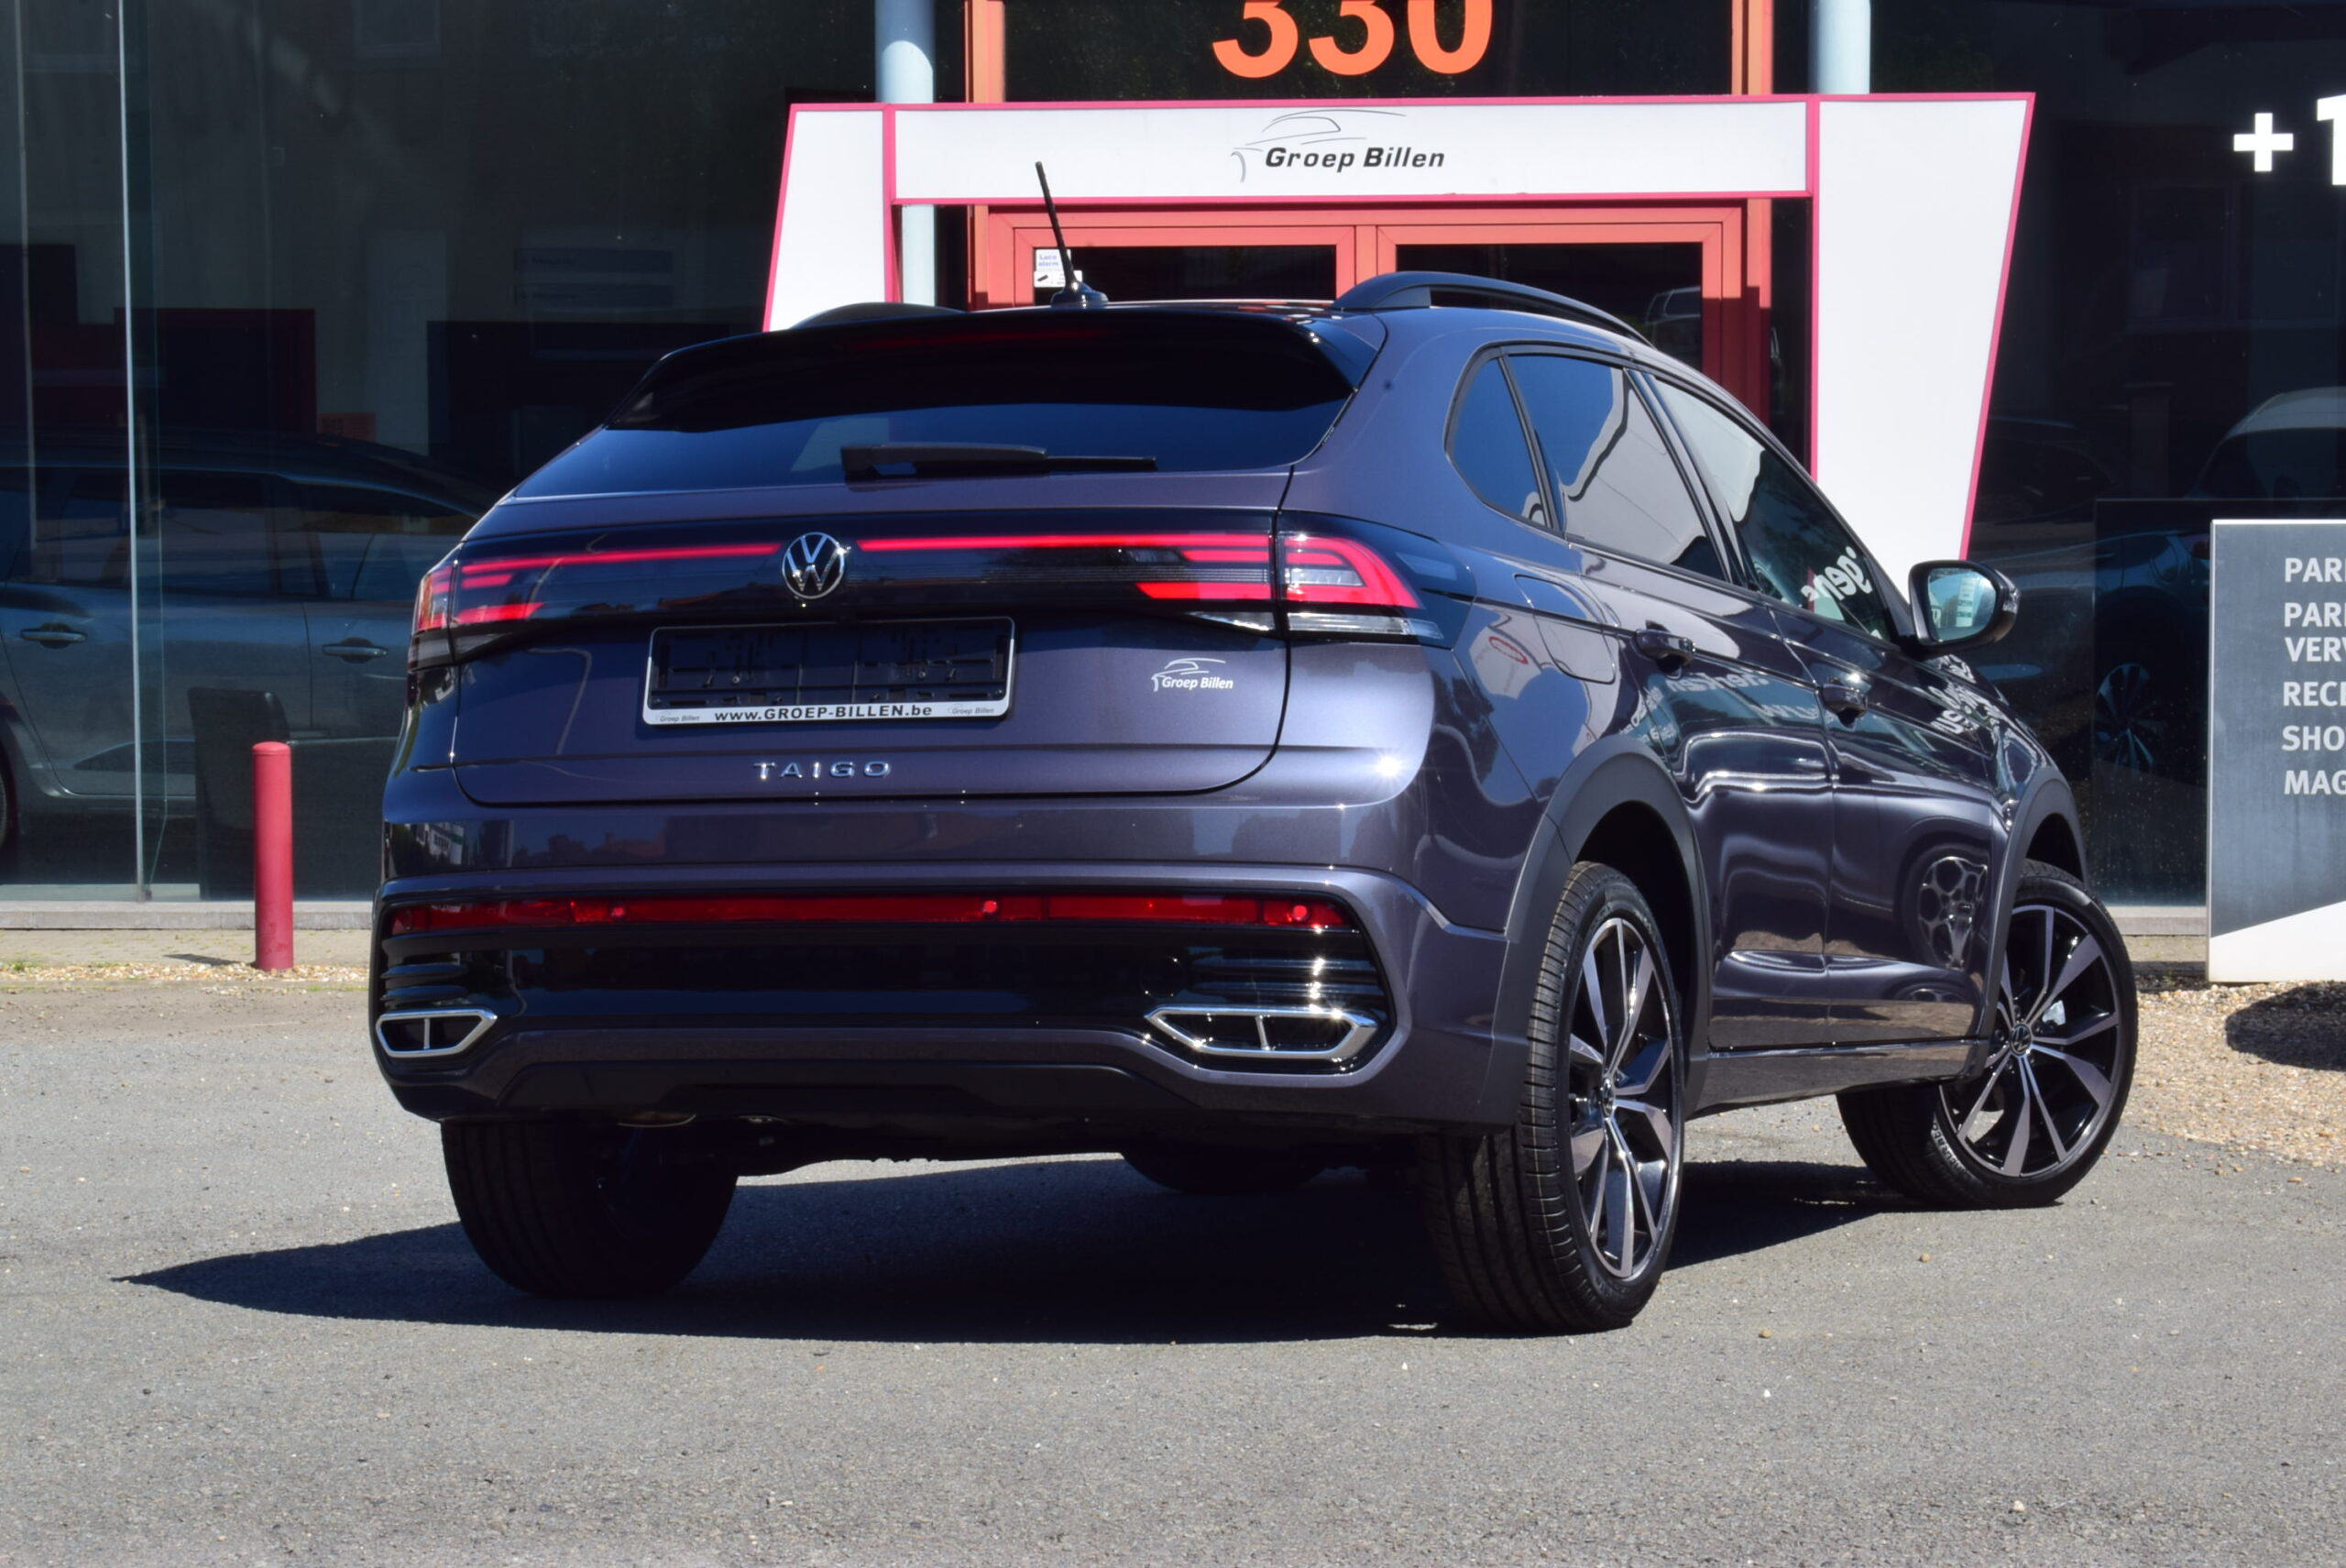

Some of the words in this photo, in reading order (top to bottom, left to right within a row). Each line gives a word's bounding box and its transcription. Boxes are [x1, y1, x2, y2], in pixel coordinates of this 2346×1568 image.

[1212, 0, 1493, 78] 330
[1265, 147, 1355, 173] Groep
[1363, 147, 1445, 168] Billen
[2285, 557, 2346, 583] PAR
[2284, 602, 2346, 628] PAR
[2284, 637, 2346, 663] VER
[1161, 676, 1198, 690] Groep
[1200, 676, 1234, 689] Billen
[715, 705, 932, 721] www.GROEP-BILLEN.be
[2281, 725, 2346, 751] SHO
[753, 761, 891, 780] TAIGO
[2284, 769, 2346, 795] MAG
